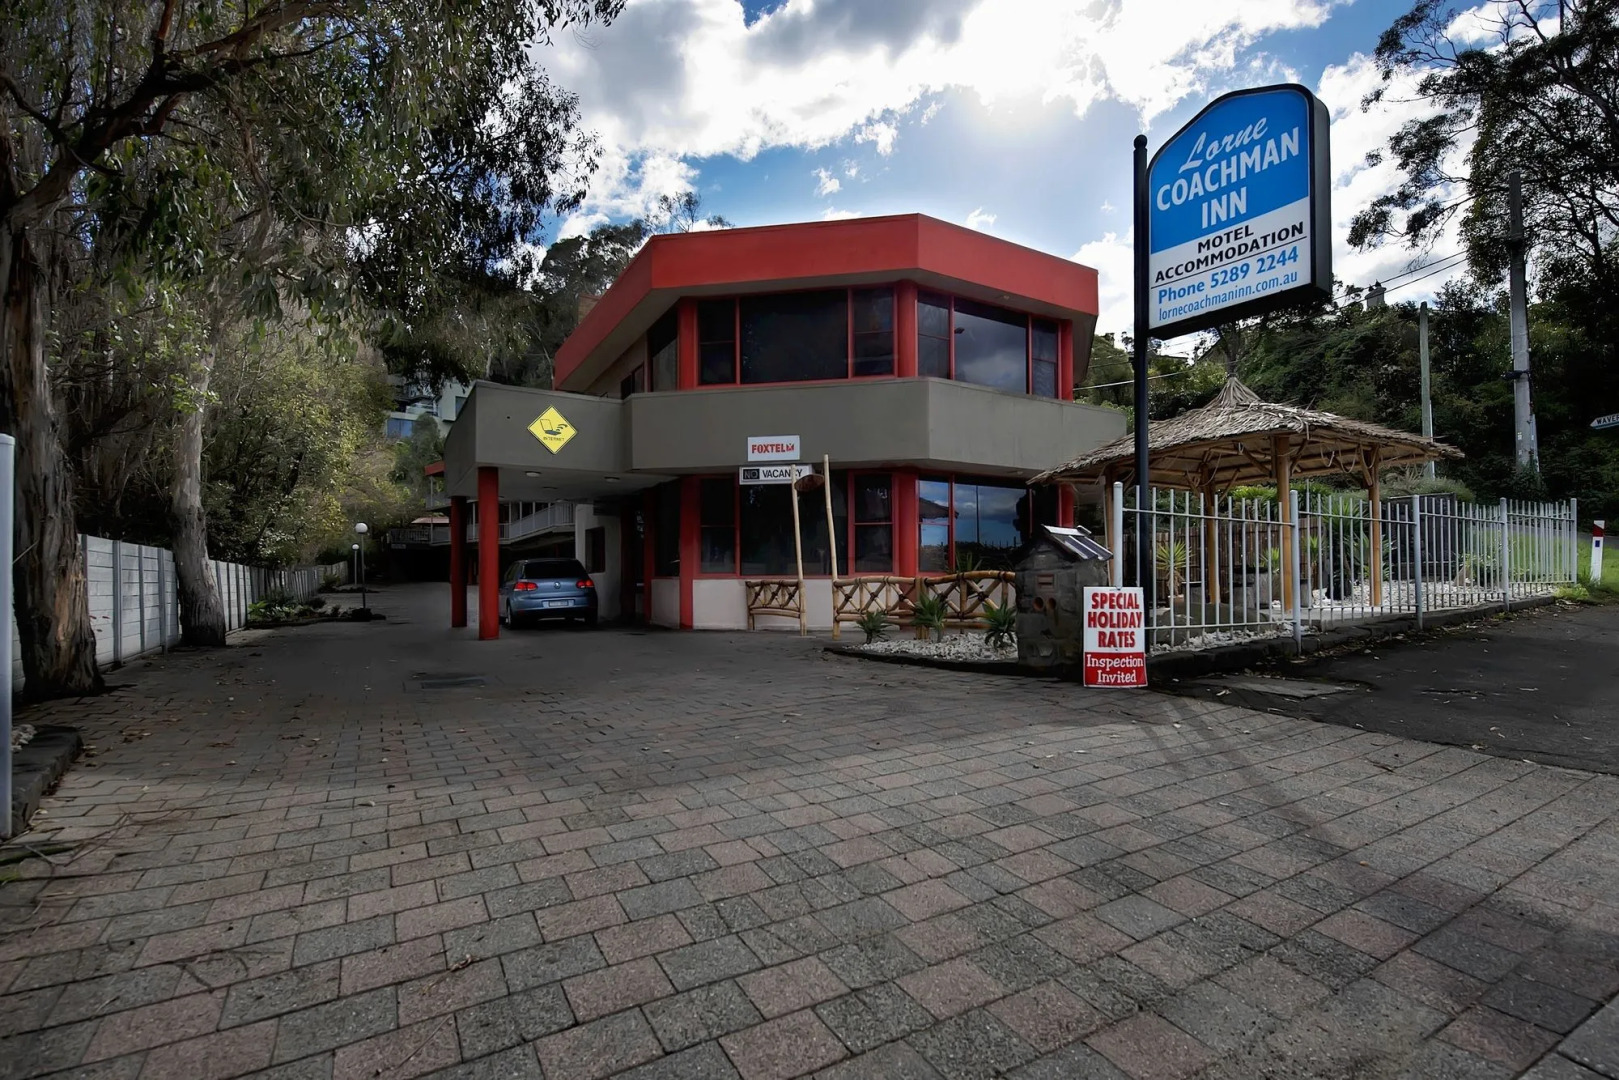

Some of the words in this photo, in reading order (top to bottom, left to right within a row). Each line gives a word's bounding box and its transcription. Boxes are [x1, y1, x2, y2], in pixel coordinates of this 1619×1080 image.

[1178, 117, 1268, 174] Lorne
[1156, 127, 1299, 211] COACHMAN
[1201, 187, 1247, 229] INN
[1197, 225, 1254, 253] MOTEL
[1155, 221, 1304, 283] ACCOMMODATION
[1158, 280, 1205, 304] Phone
[1210, 263, 1250, 289] 5289
[1256, 246, 1298, 274] 2244
[1159, 271, 1298, 321] lornecoachmaninn.com.au
[751, 443, 786, 454] FOXTEL
[744, 470, 758, 479] NO
[762, 469, 803, 478] VACANY
[1091, 592, 1140, 609] SPECIAL
[1087, 611, 1142, 628] HOLIDAY
[1098, 631, 1135, 648] RATES
[1086, 654, 1144, 671] Inspection
[1097, 669, 1137, 683] Invited
